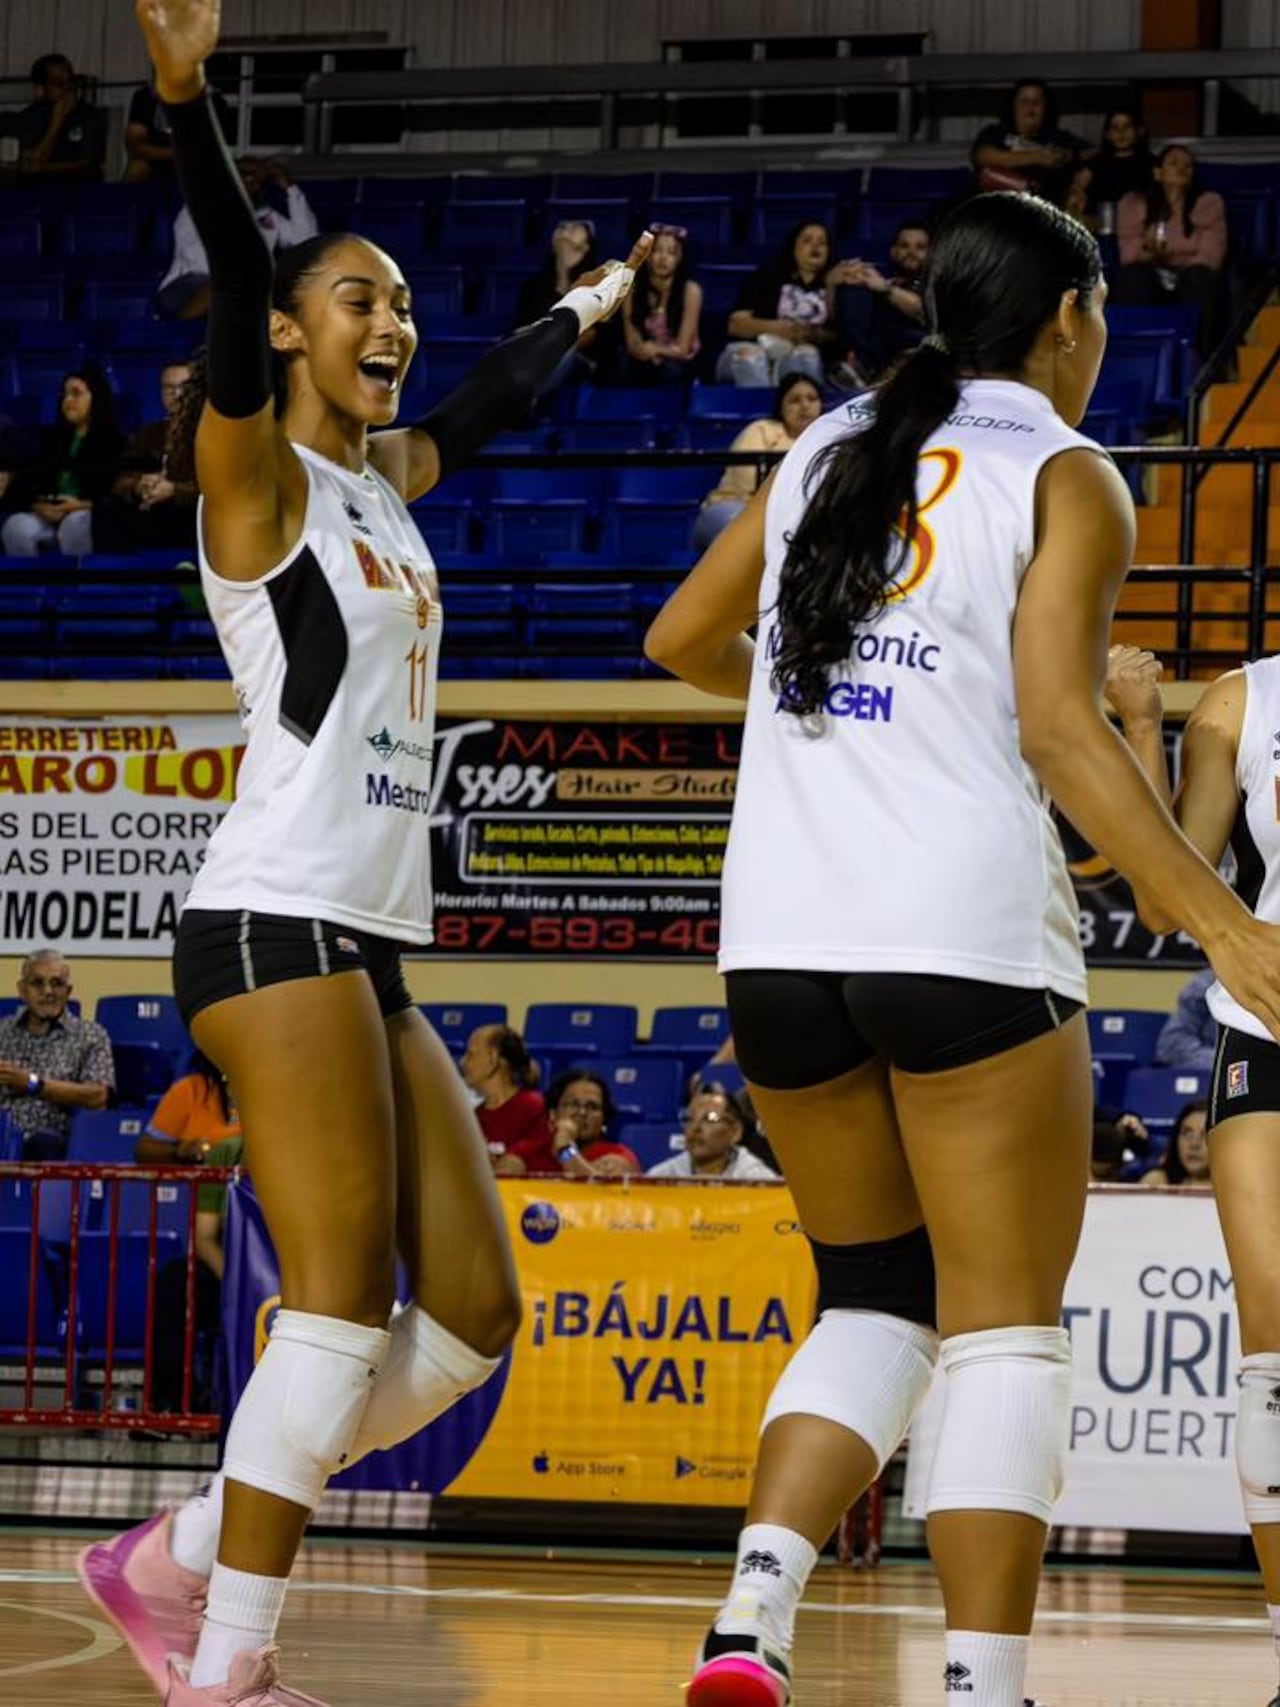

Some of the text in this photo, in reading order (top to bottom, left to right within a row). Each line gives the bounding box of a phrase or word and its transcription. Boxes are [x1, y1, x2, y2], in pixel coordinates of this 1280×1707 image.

[0, 726, 178, 752] ERRETERIA
[496, 724, 690, 763] MAKE
[569, 772, 738, 797] Hair Stud
[32, 812, 99, 839] DEL
[0, 848, 49, 876] AS
[0, 890, 179, 940] MODELA
[502, 895, 559, 911] Martes
[561, 896, 576, 911] A
[531, 1280, 794, 1347] ¡BÁJALA
[611, 1355, 707, 1405] YA!
[1068, 1406, 1237, 1459] PUERT
